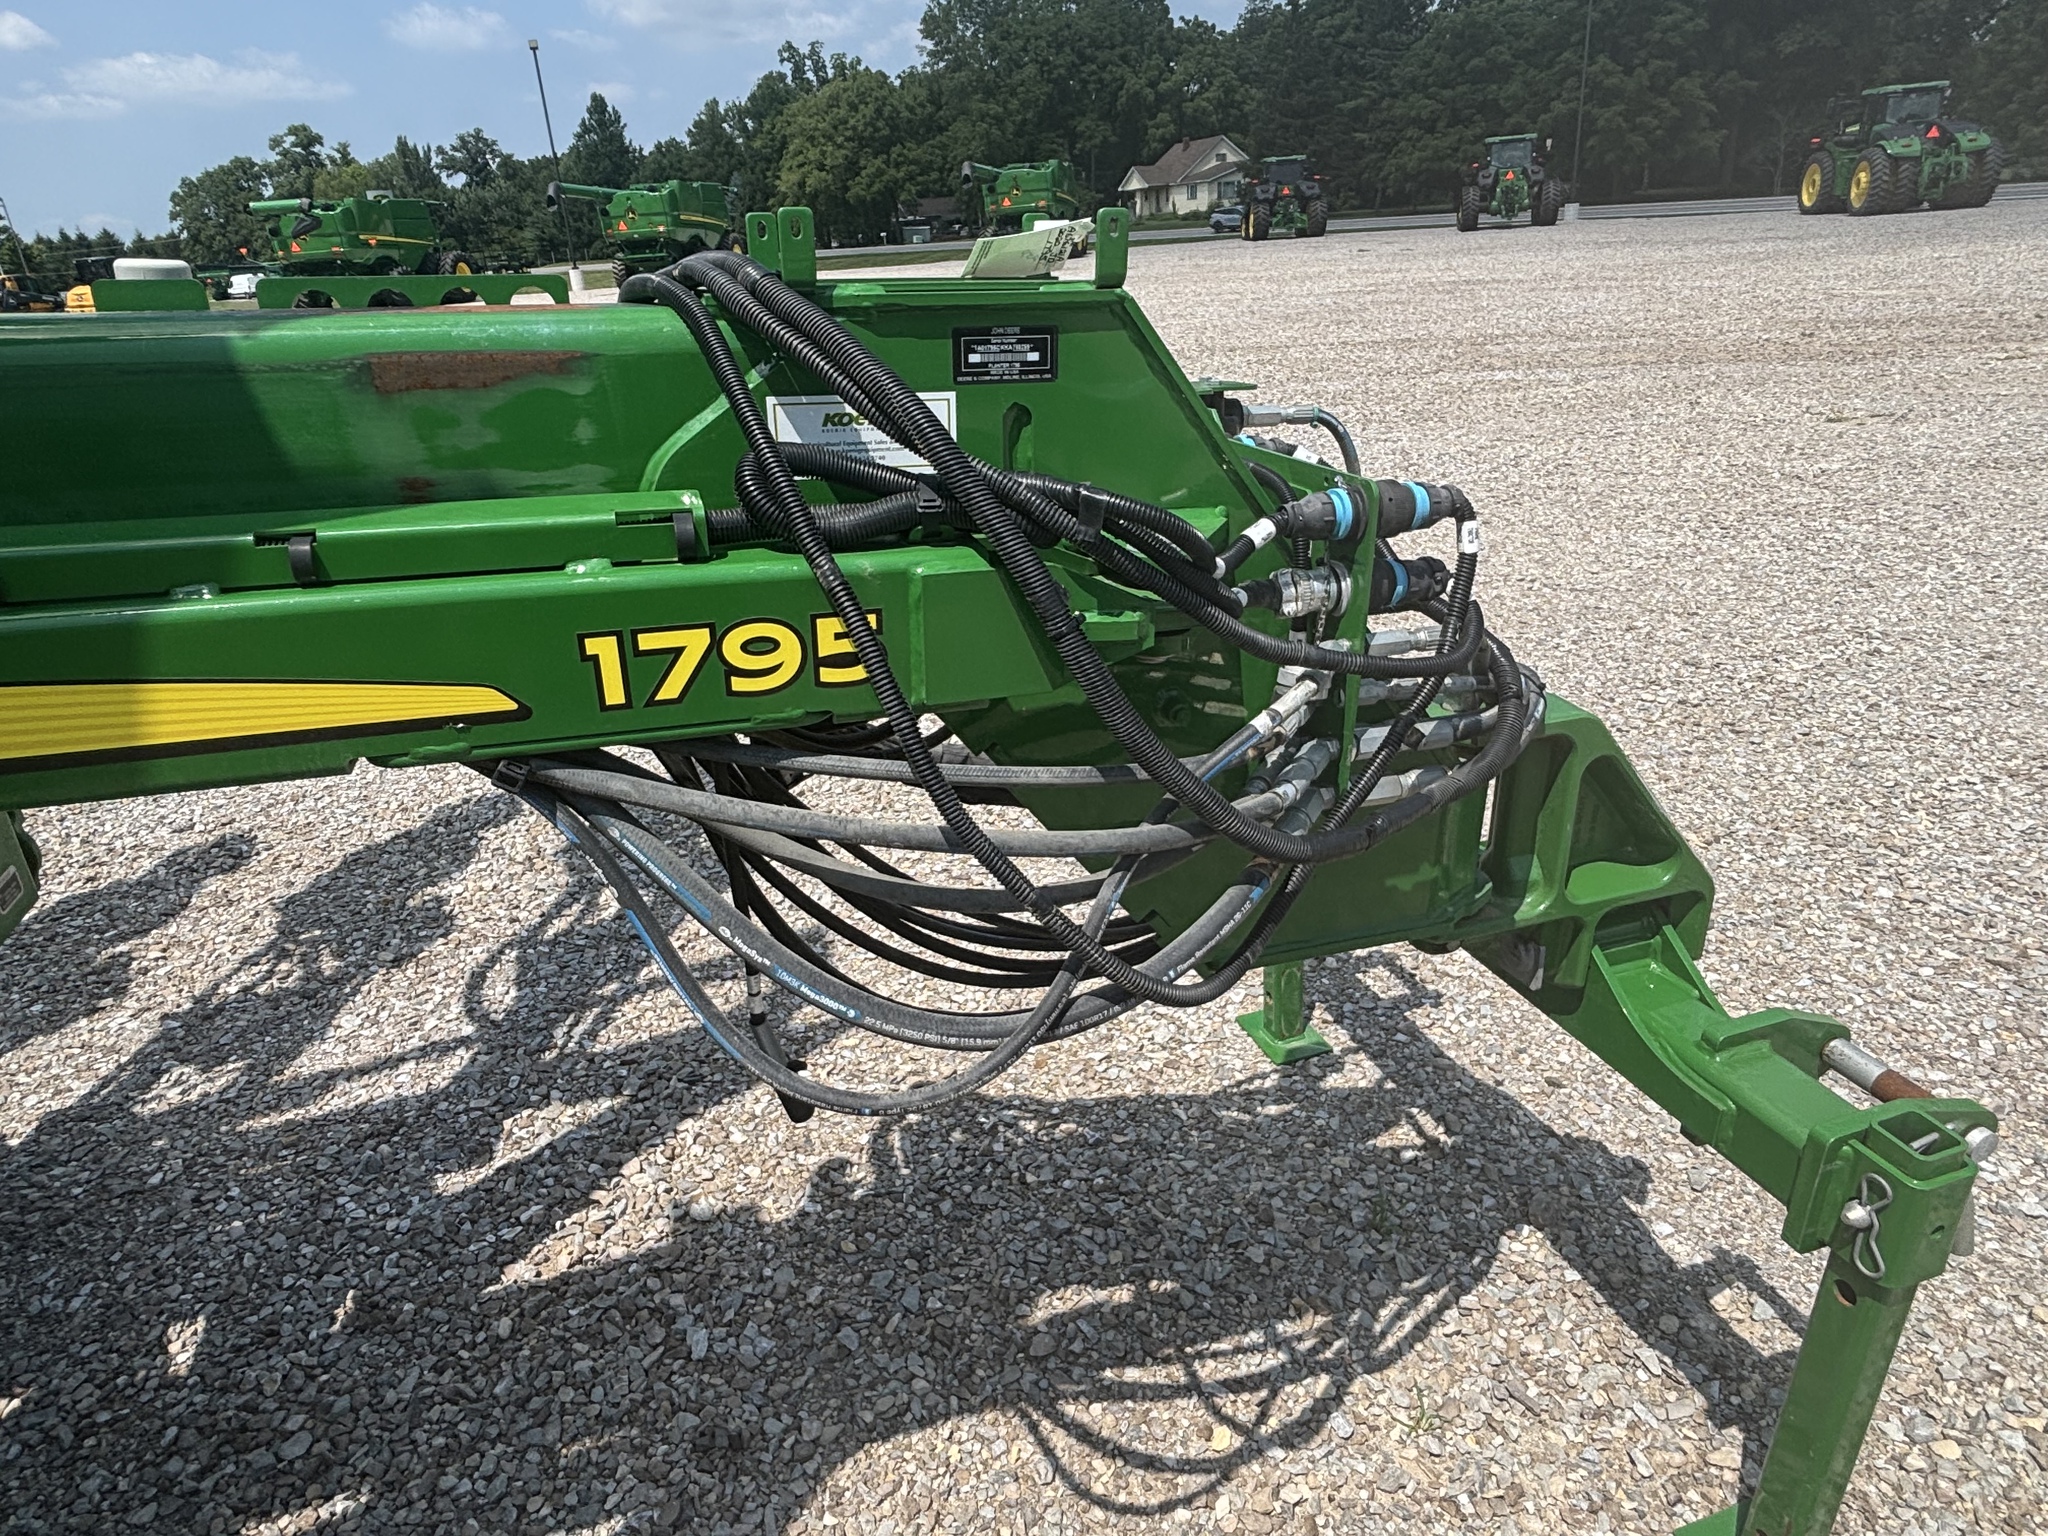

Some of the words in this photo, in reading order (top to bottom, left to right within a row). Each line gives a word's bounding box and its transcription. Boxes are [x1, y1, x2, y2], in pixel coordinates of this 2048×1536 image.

[577, 609, 883, 711] 1795
[621, 838, 648, 864] POWERING
[1176, 958, 1196, 973] Flame
[1195, 933, 1221, 959] Resistant
[1220, 920, 1236, 937] MSHA
[864, 1016, 881, 1029] 22.5
[882, 1022, 898, 1034] MPa
